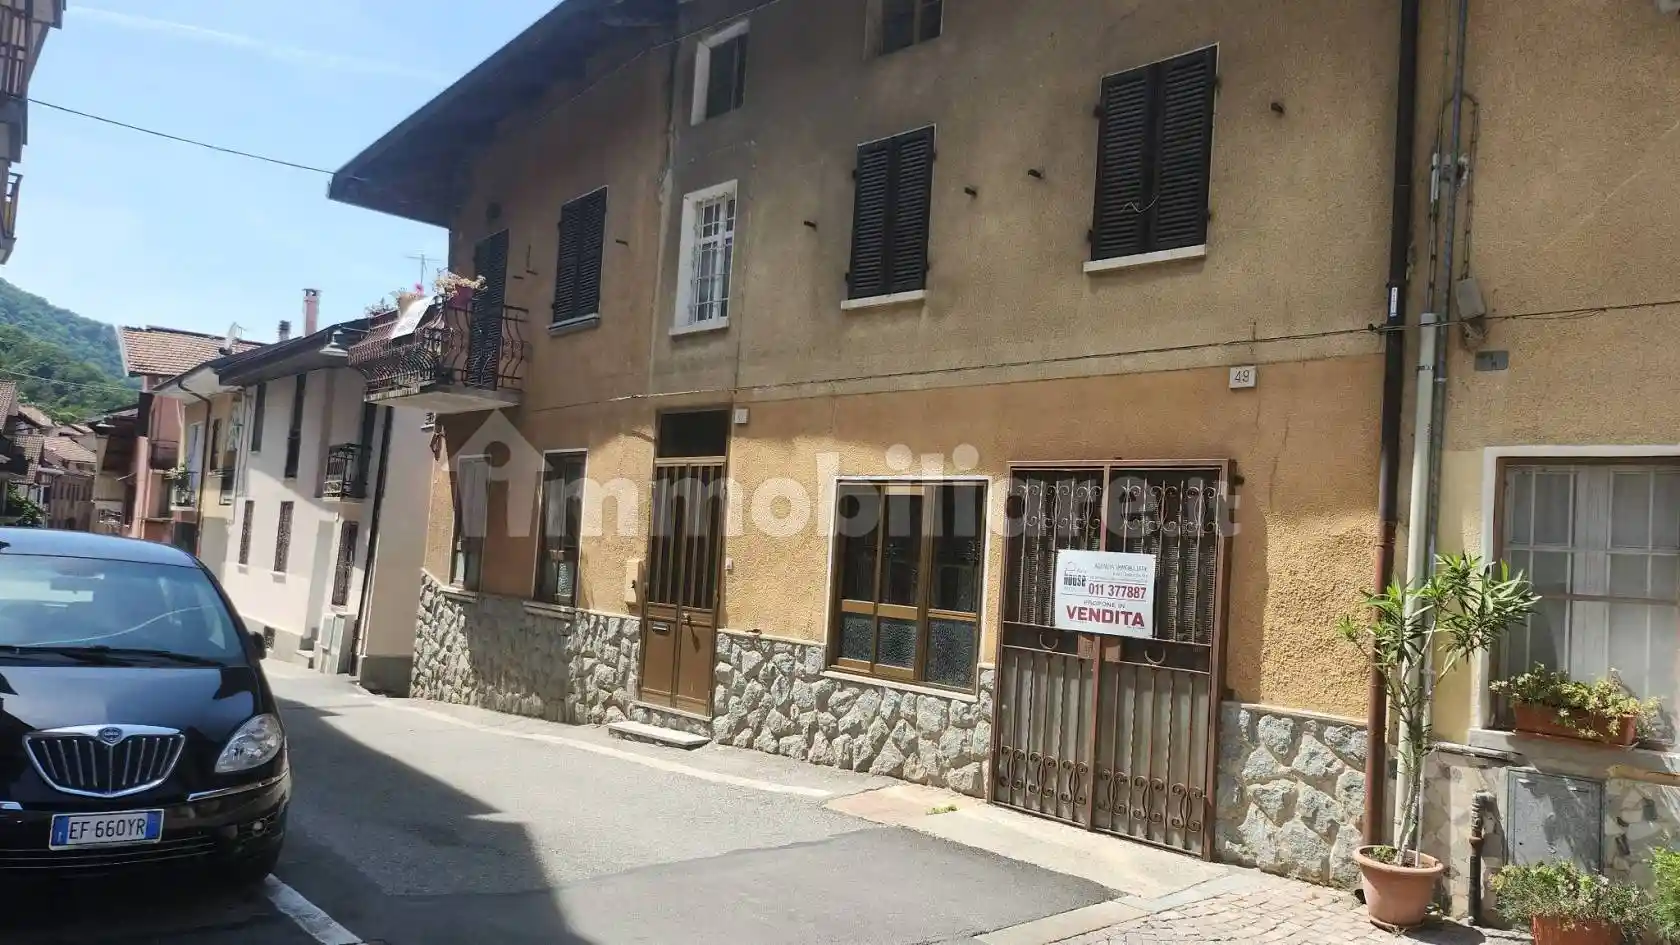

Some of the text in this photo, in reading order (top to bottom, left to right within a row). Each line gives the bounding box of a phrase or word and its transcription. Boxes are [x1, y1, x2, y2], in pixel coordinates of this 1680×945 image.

[1235, 369, 1250, 383] 49
[1088, 583, 1104, 596] 011
[1108, 584, 1147, 599] 377887
[1066, 605, 1145, 627] VENDITA
[68, 817, 146, 840] EF 660YR
